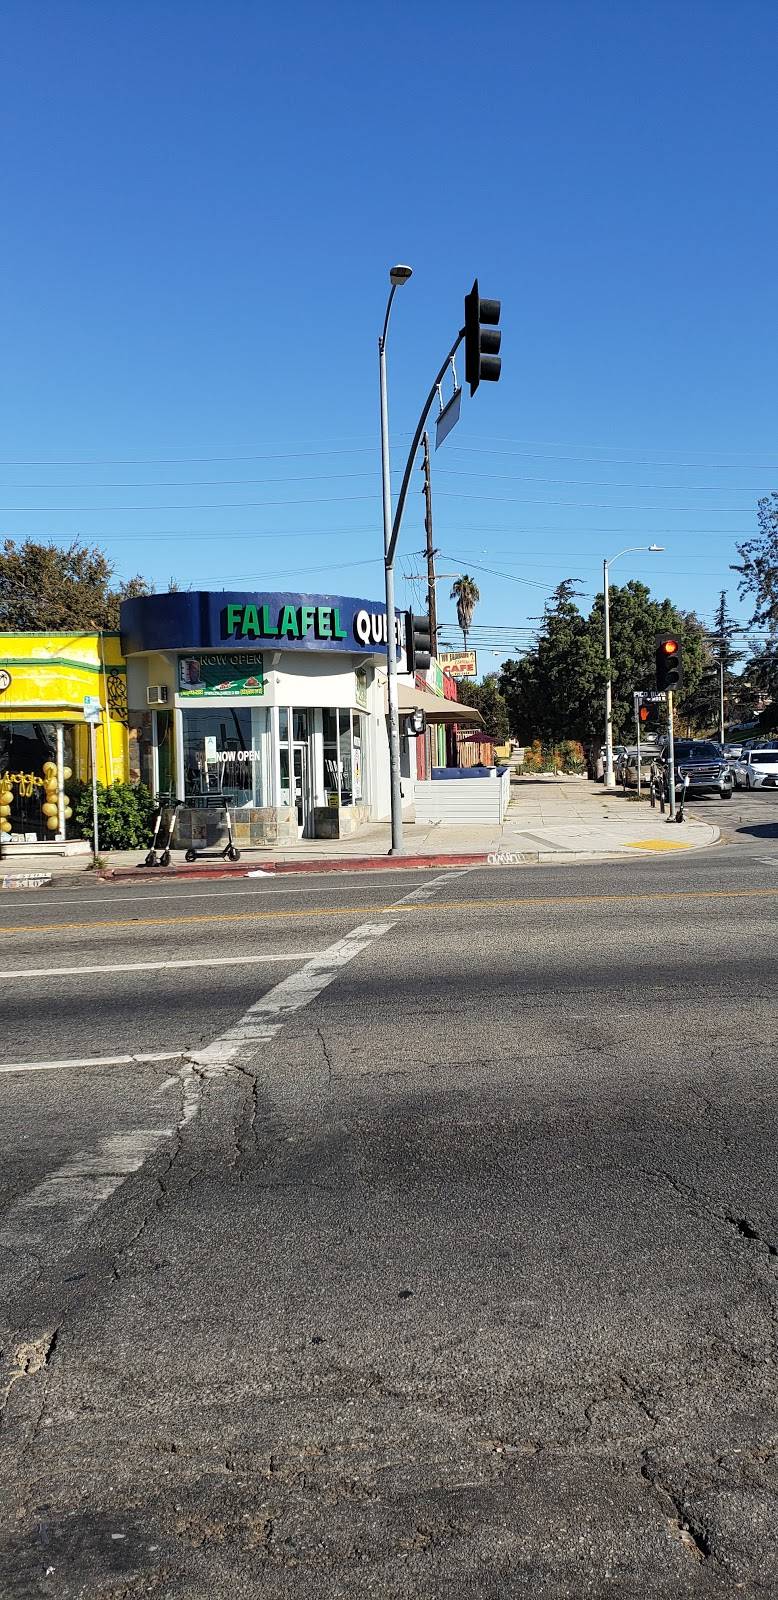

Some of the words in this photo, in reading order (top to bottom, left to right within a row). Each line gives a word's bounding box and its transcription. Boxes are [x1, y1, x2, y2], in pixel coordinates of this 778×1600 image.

[226, 603, 348, 638] FALAFEL
[201, 655, 227, 666] NOW
[230, 653, 262, 665] OPEN
[443, 663, 474, 672] CAFE
[216, 751, 236, 762] NOW
[237, 750, 260, 762] OPEN
